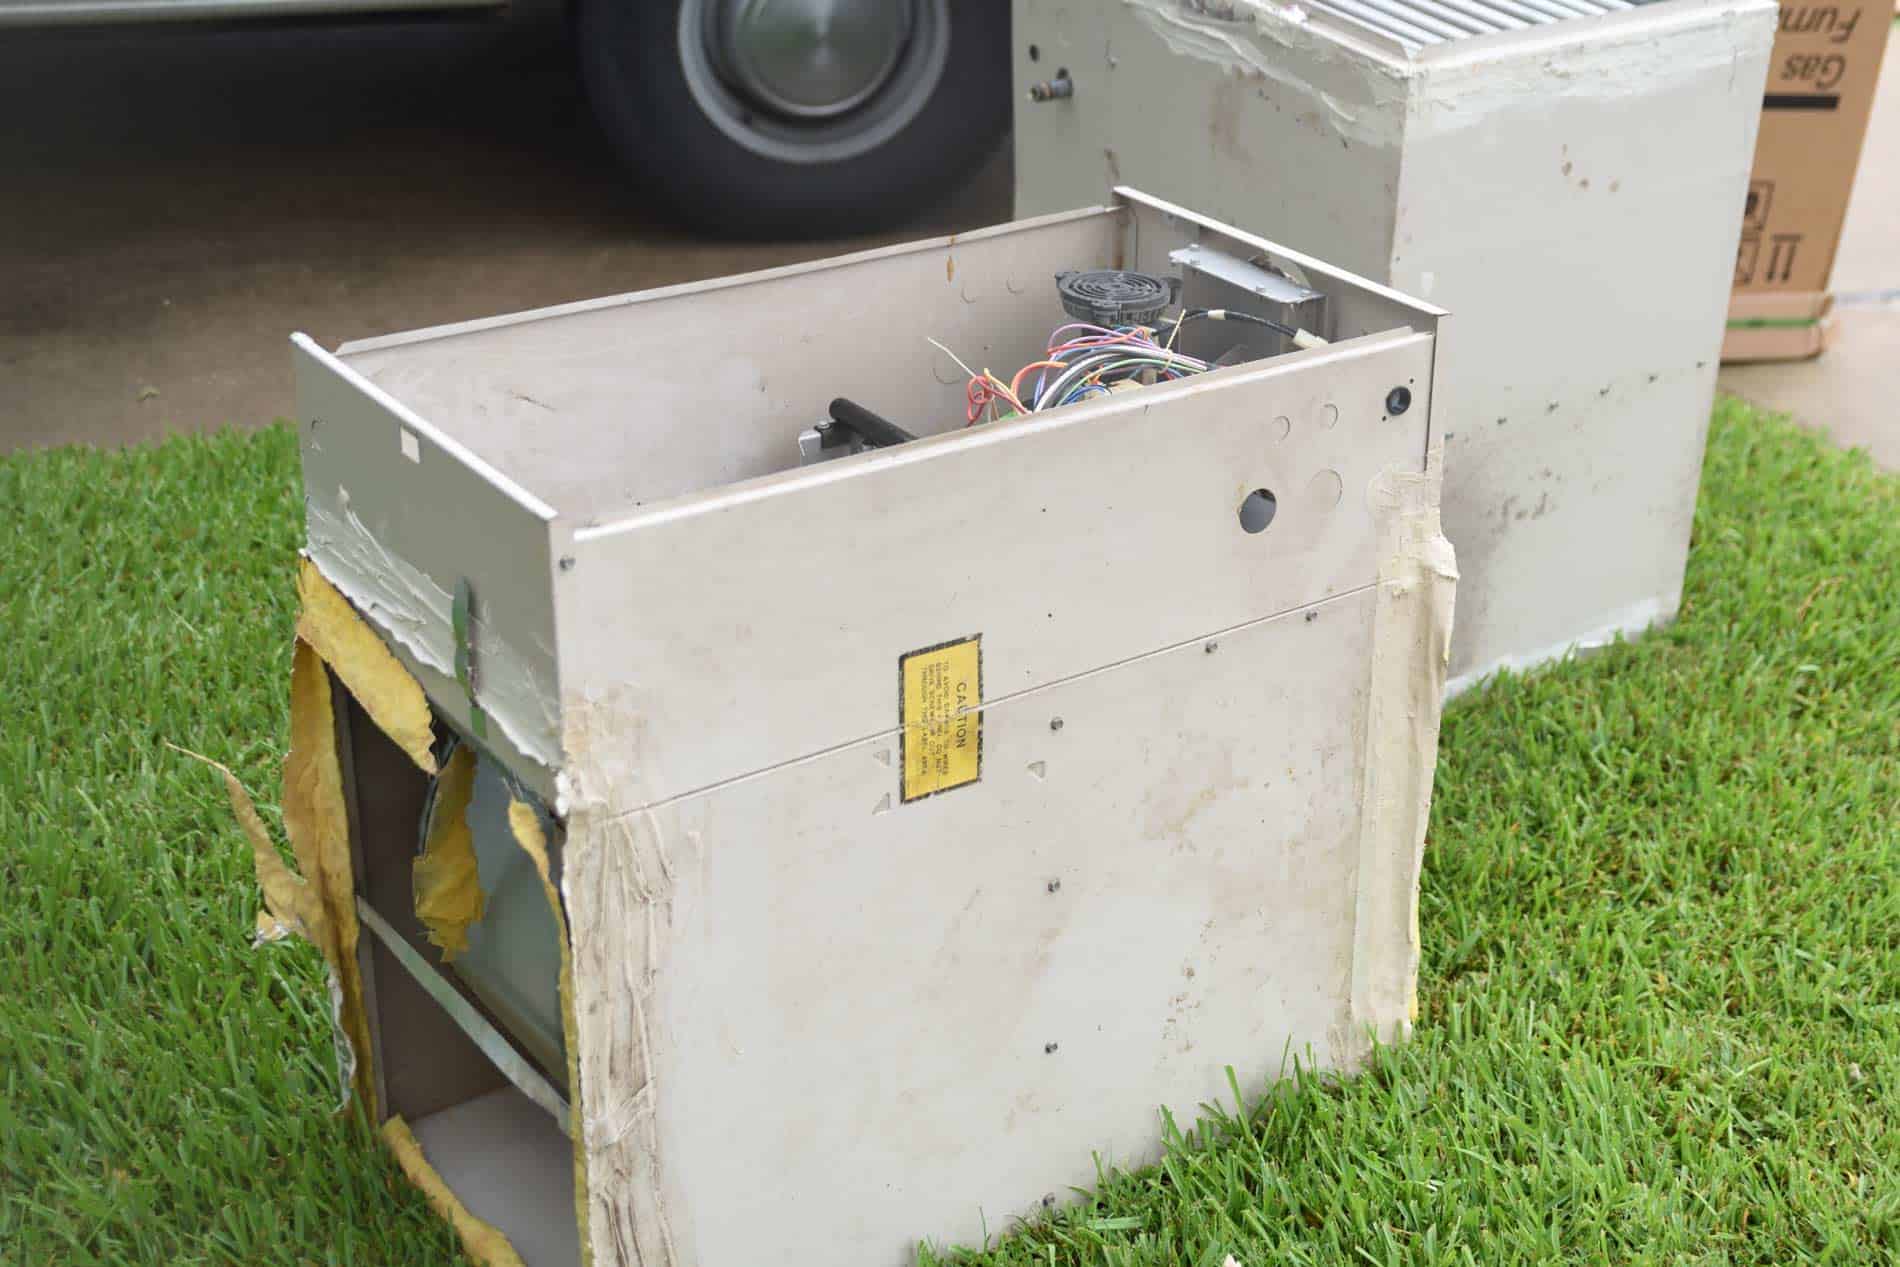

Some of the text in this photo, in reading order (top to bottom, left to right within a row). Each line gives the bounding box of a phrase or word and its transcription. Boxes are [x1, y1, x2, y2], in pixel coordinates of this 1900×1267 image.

[1779, 6, 1862, 43] Furn
[1782, 54, 1847, 90] Gas
[956, 682, 967, 748] CAUTION
